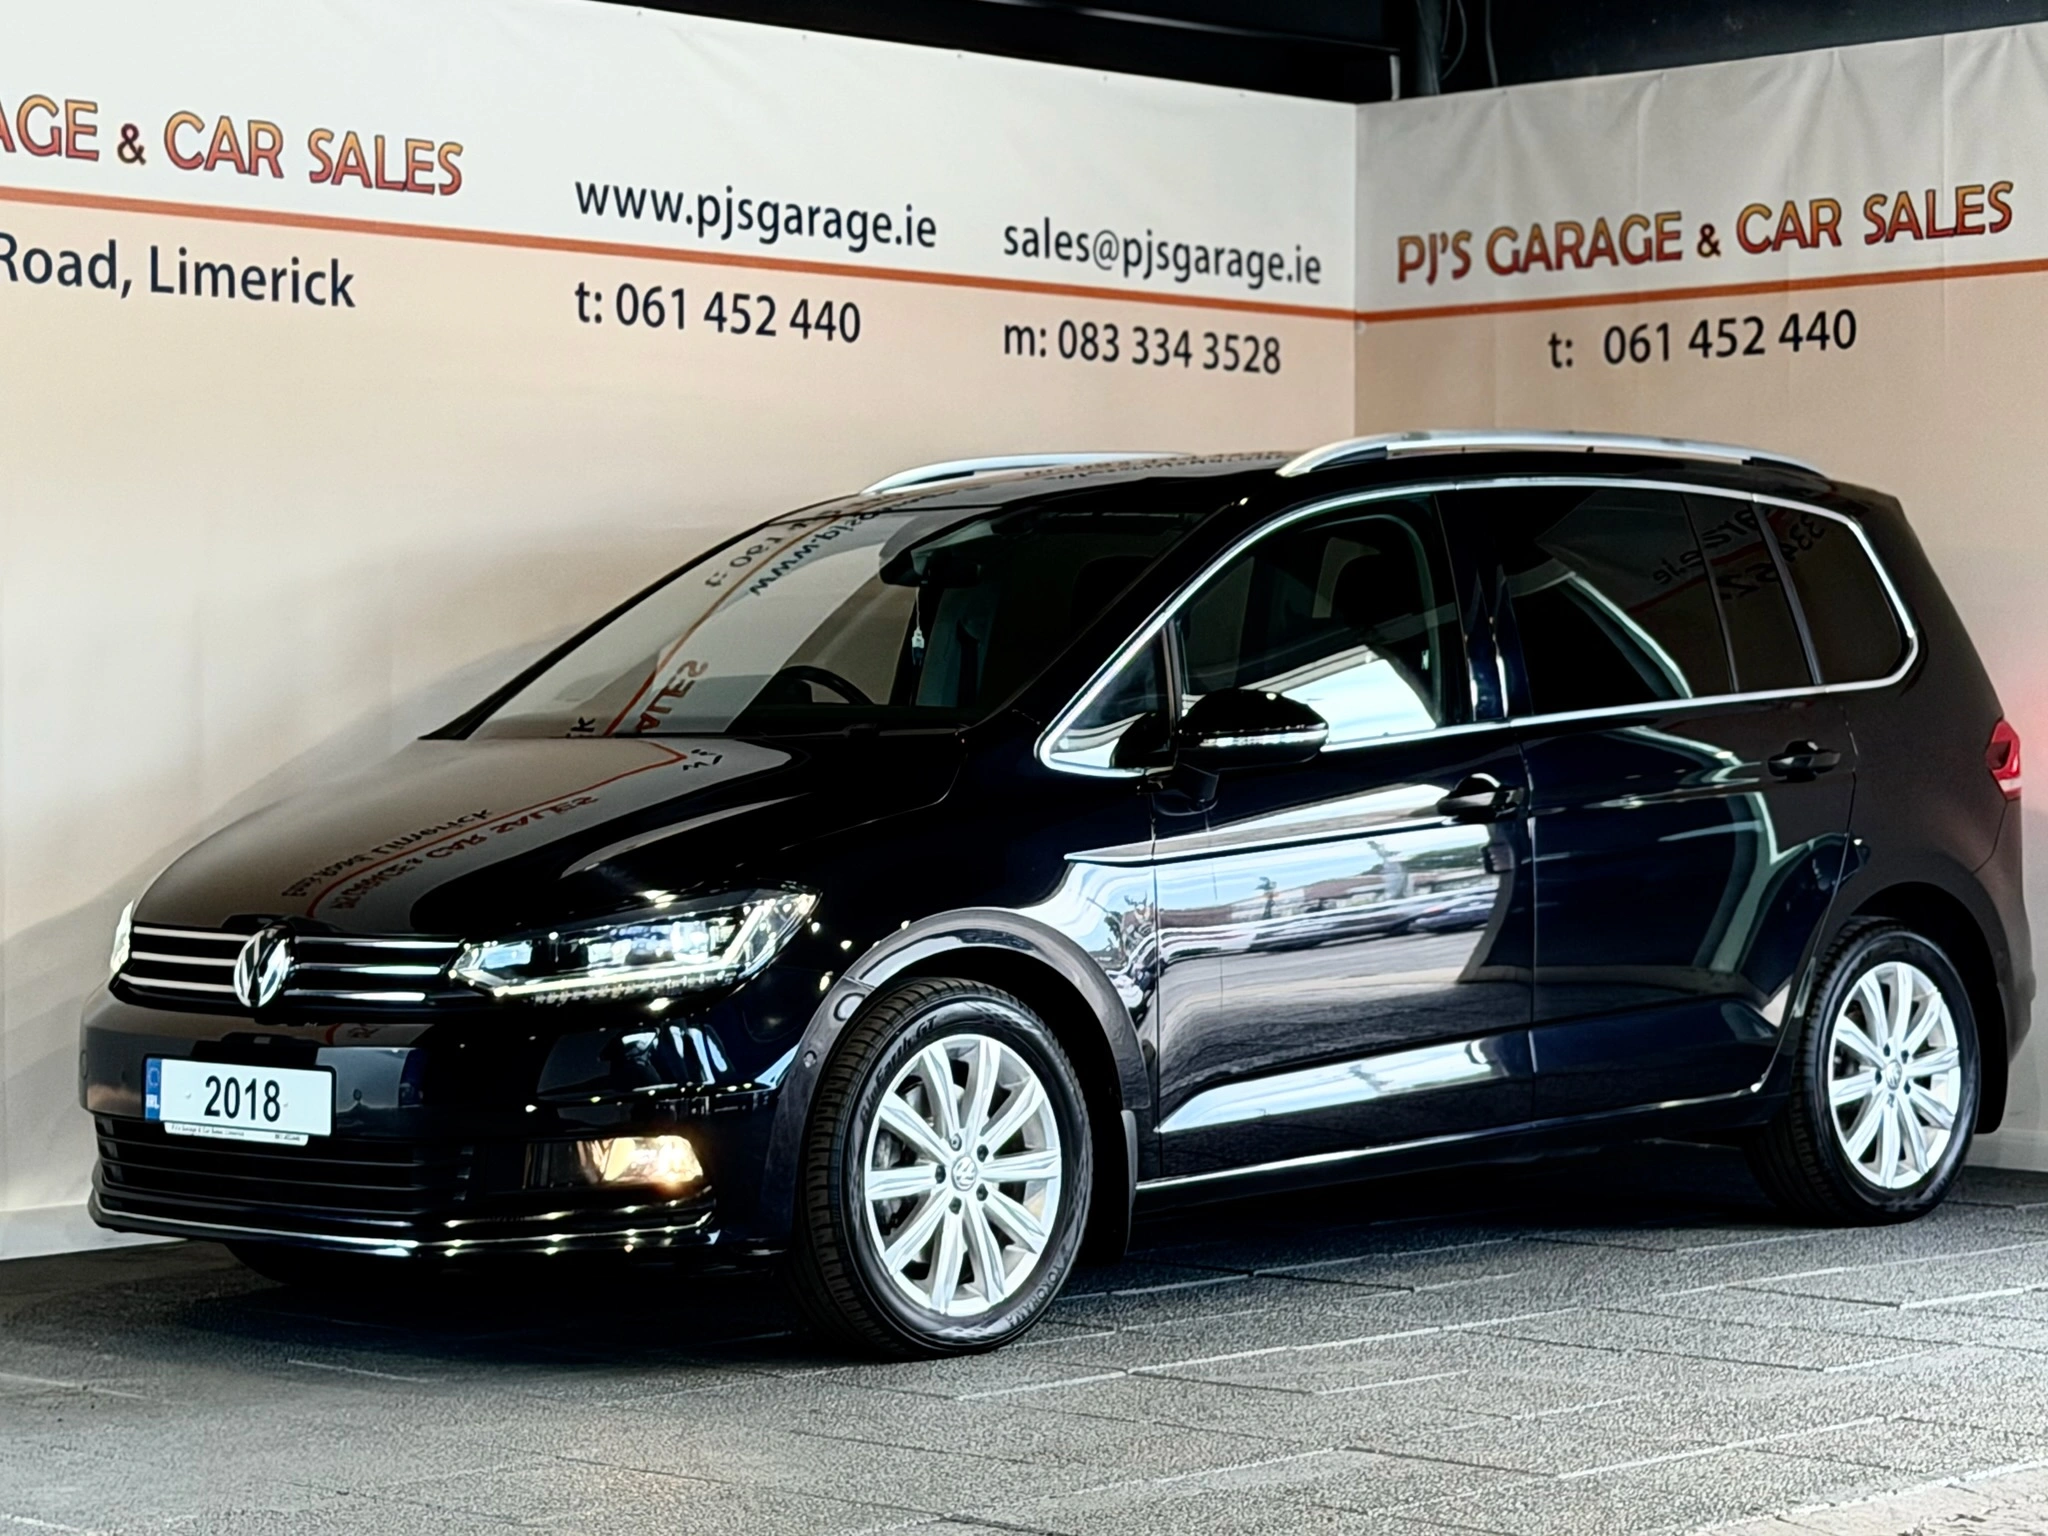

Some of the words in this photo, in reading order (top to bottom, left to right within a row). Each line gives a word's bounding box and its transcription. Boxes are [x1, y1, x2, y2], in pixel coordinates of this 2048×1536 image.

[117, 123, 147, 165] &
[163, 110, 285, 179] CAR
[307, 128, 464, 196] SALES
[575, 181, 937, 253] www.pjsgarage.ie
[1398, 229, 1473, 285] PJ'S
[1485, 210, 1683, 276] GARAGE
[1696, 223, 1722, 258] &
[1736, 197, 1843, 254] CAR
[1862, 180, 2014, 246] SALES
[0, 232, 132, 299] Road,
[150, 245, 356, 308] Limerick
[1003, 217, 1322, 290] sales@pjsgarage.ie
[575, 282, 602, 324] t:
[615, 283, 686, 330] 061
[703, 291, 777, 337] 452
[789, 298, 861, 344] 440
[1004, 323, 1047, 358] m:
[1058, 320, 1120, 363] 083
[1131, 326, 1193, 369] 334
[1202, 331, 1282, 375] 3528
[1547, 332, 1574, 368] t:
[1604, 322, 1671, 365] 061
[1687, 316, 1766, 359] 452
[1778, 309, 1857, 352] 440
[203, 1075, 281, 1122] 2018
